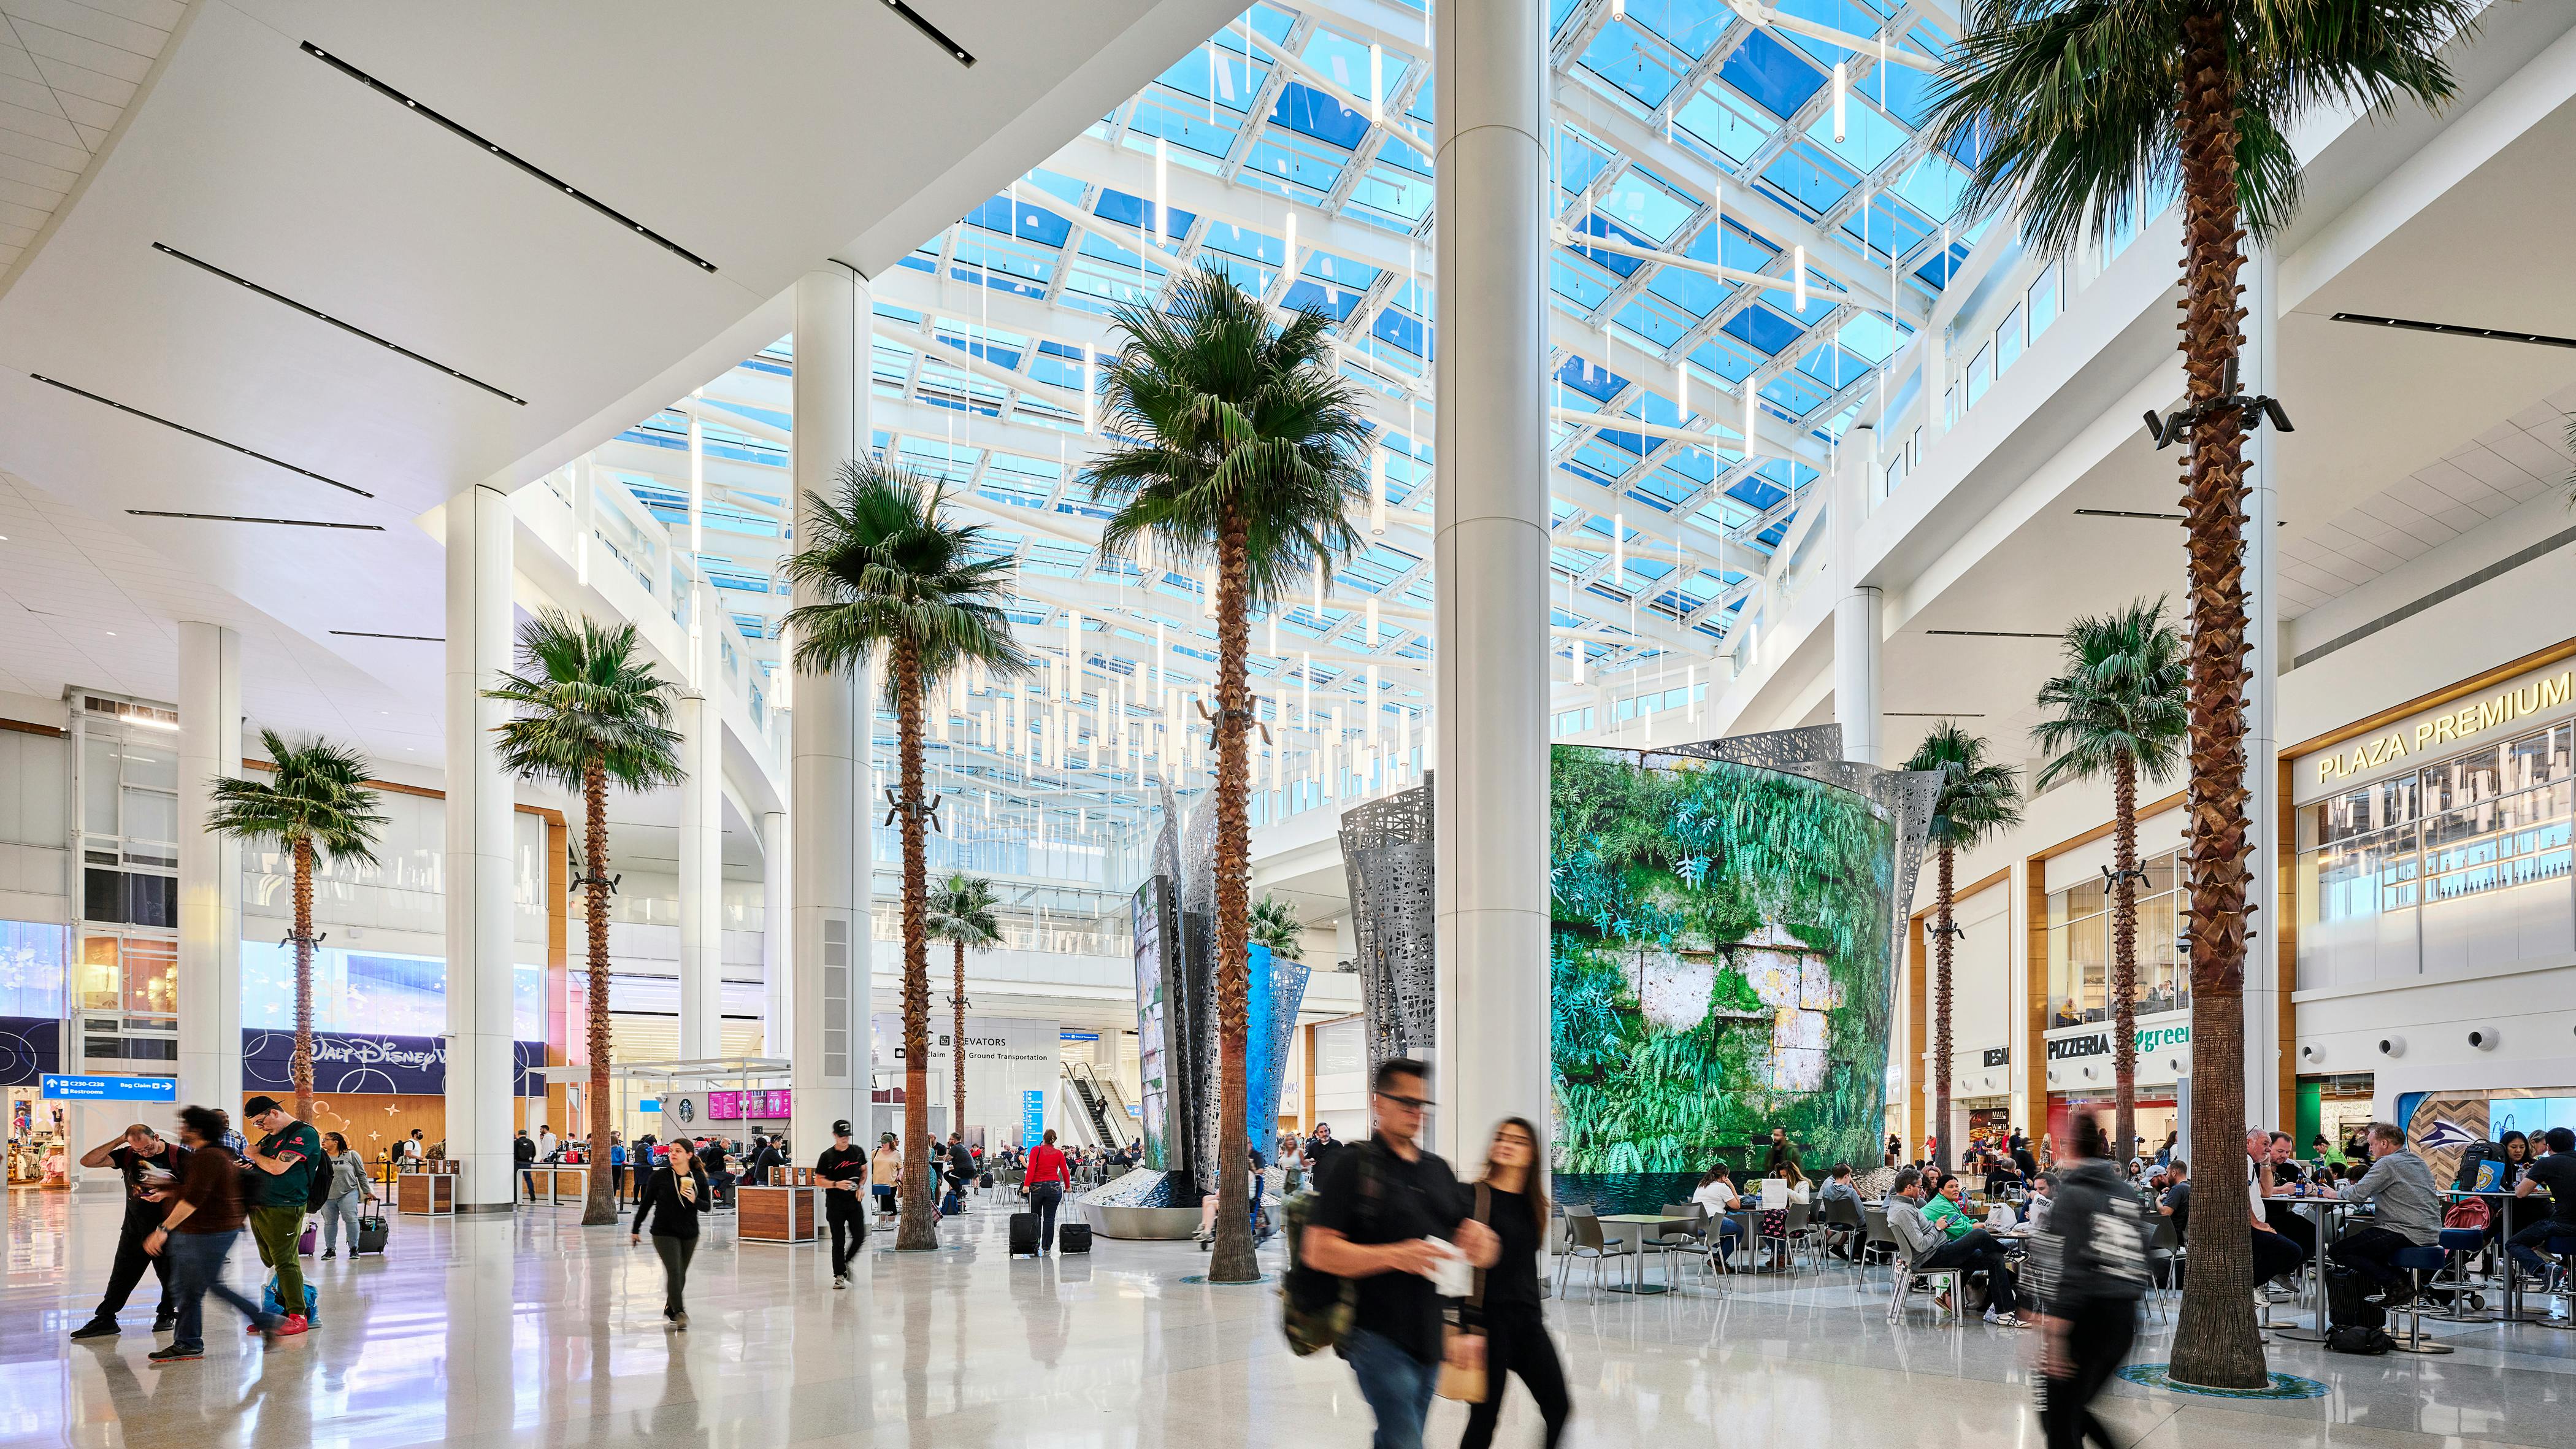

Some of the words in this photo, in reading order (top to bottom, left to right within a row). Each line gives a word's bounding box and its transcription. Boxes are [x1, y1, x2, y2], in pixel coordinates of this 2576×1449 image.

[2318, 734, 2407, 784] PLAZA
[2415, 672, 2572, 751] PREMIUM
[964, 1037, 1006, 1047] EVATORS
[2047, 1033, 2111, 1060] PIZZERIA
